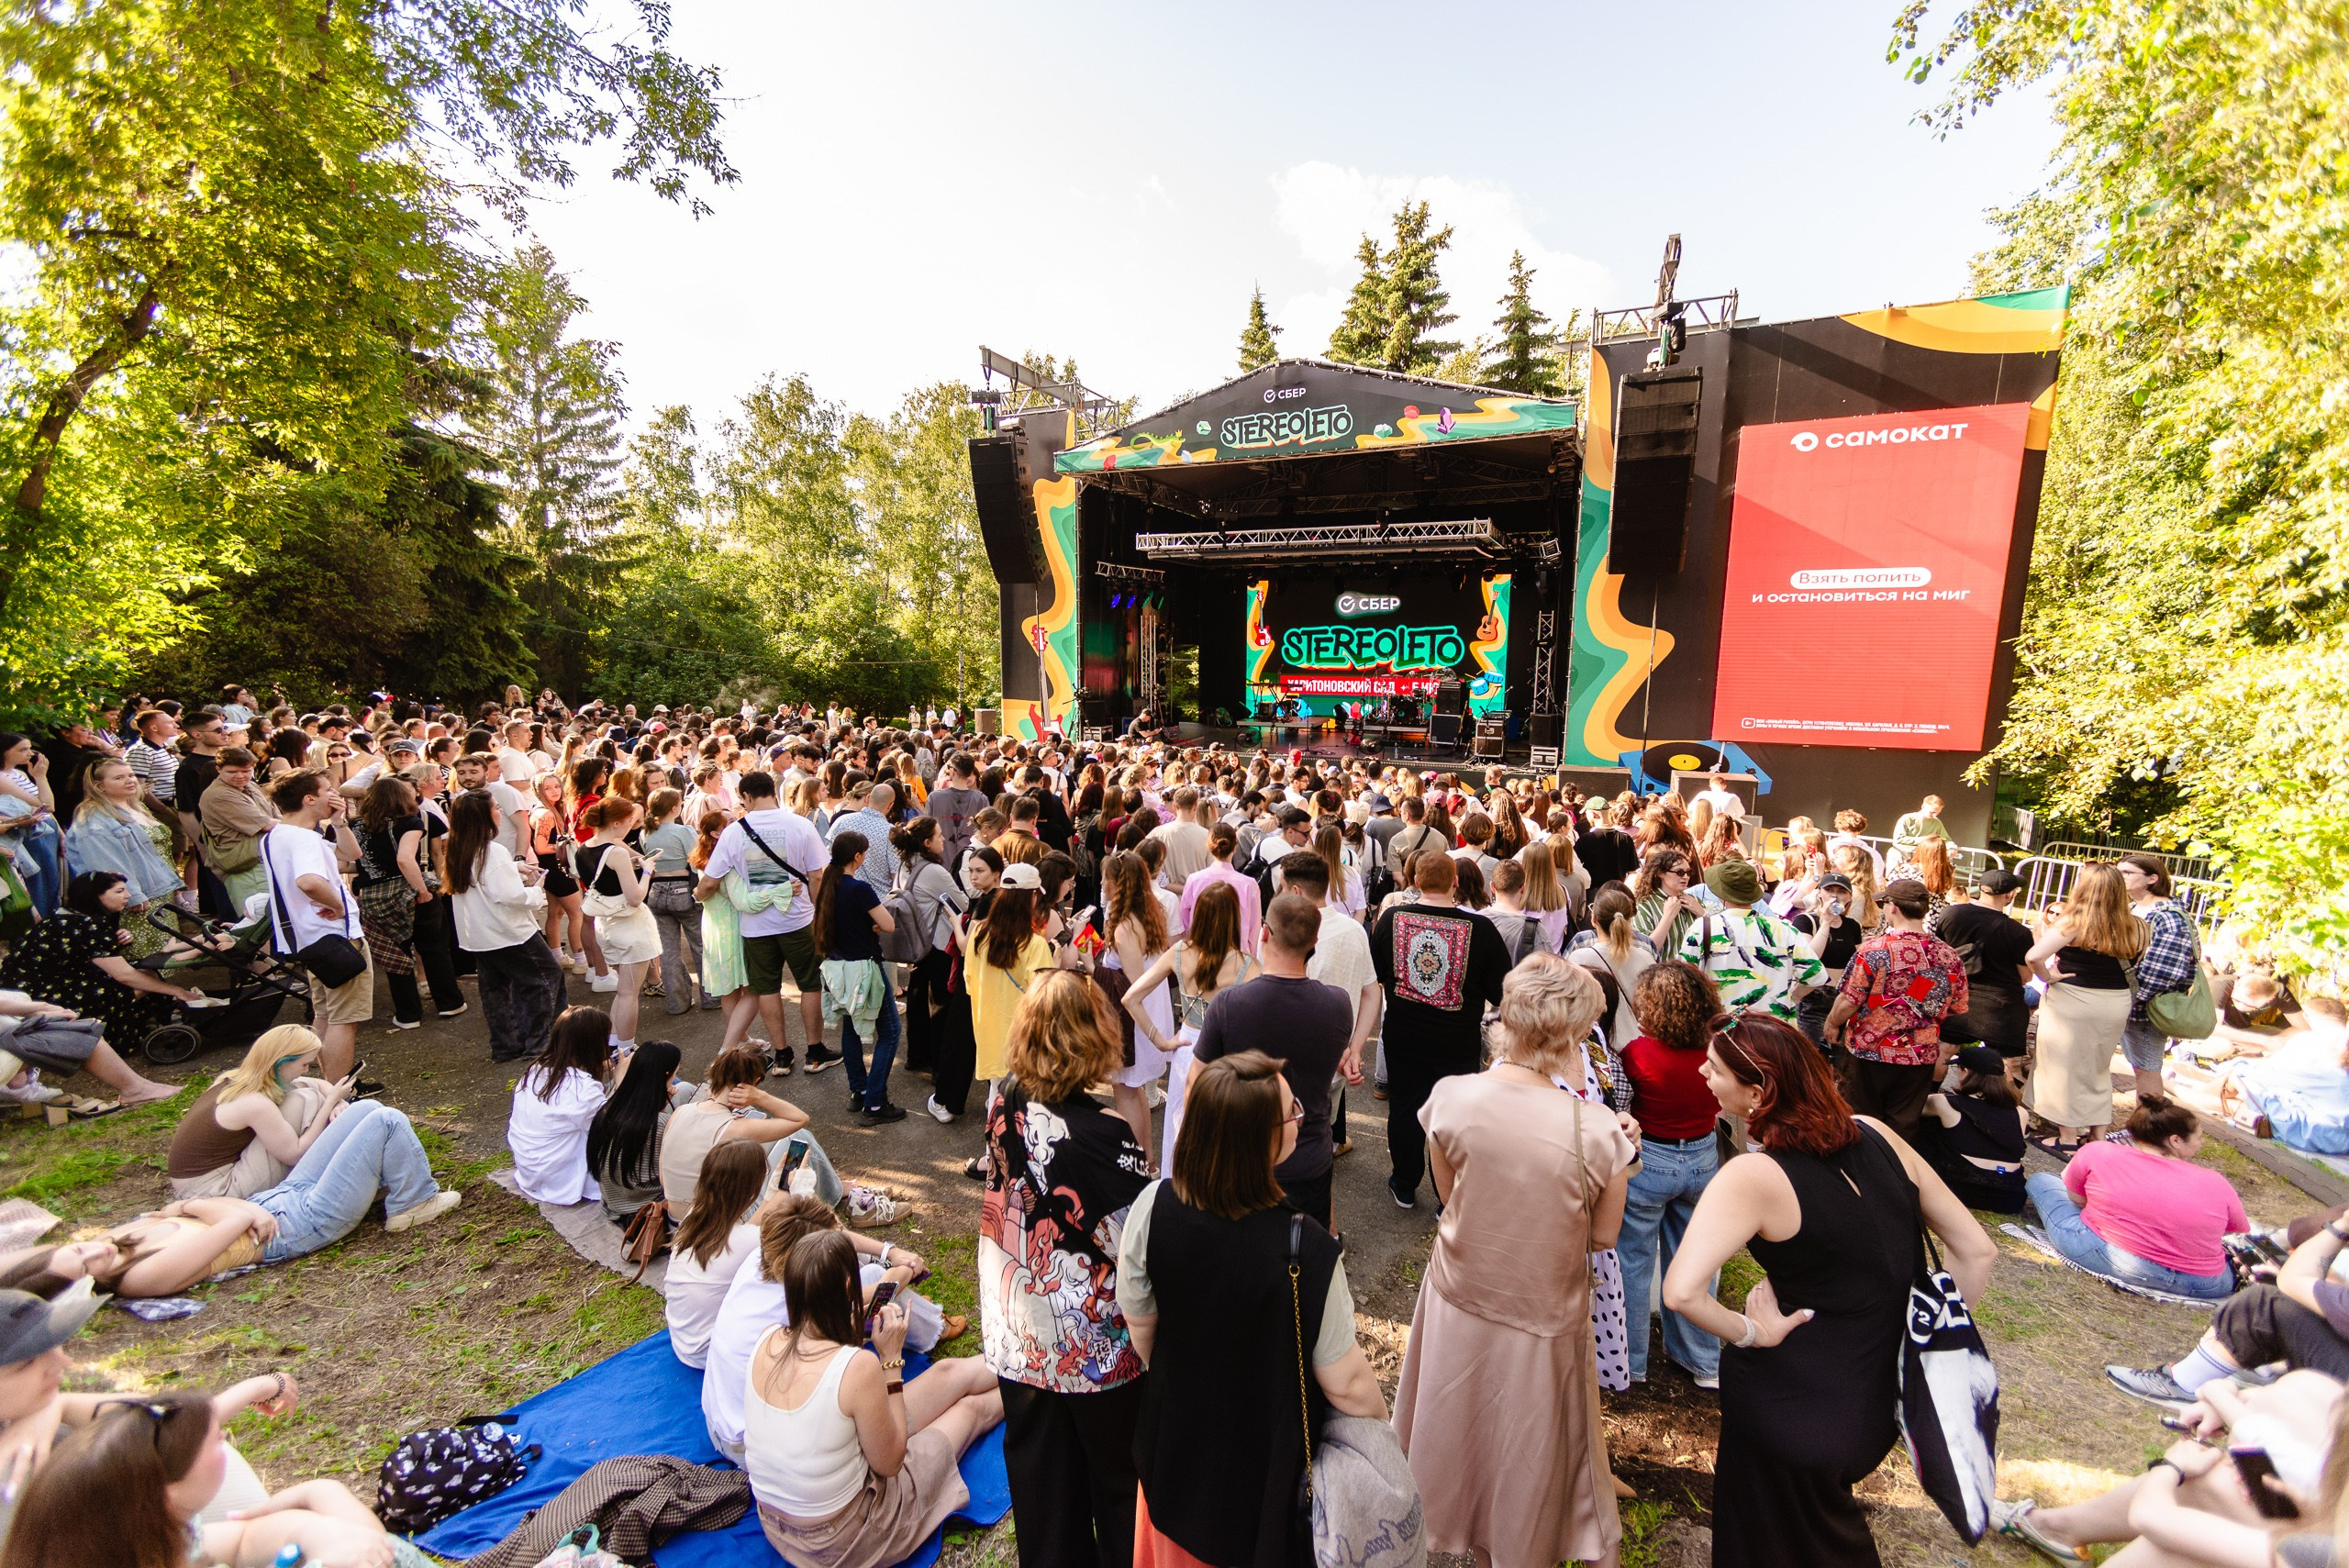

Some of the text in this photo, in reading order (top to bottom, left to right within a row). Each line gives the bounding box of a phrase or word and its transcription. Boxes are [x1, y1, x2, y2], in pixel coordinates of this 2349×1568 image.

[1277, 387, 1307, 400] СБЕР
[1221, 405, 1353, 447] STEREOLETO
[1799, 573, 1921, 584] Взять попить
[1752, 590, 1971, 603] и остановиться на миг
[1358, 597, 1400, 610] СБЕР
[1283, 626, 1464, 669] STEREOLETO
